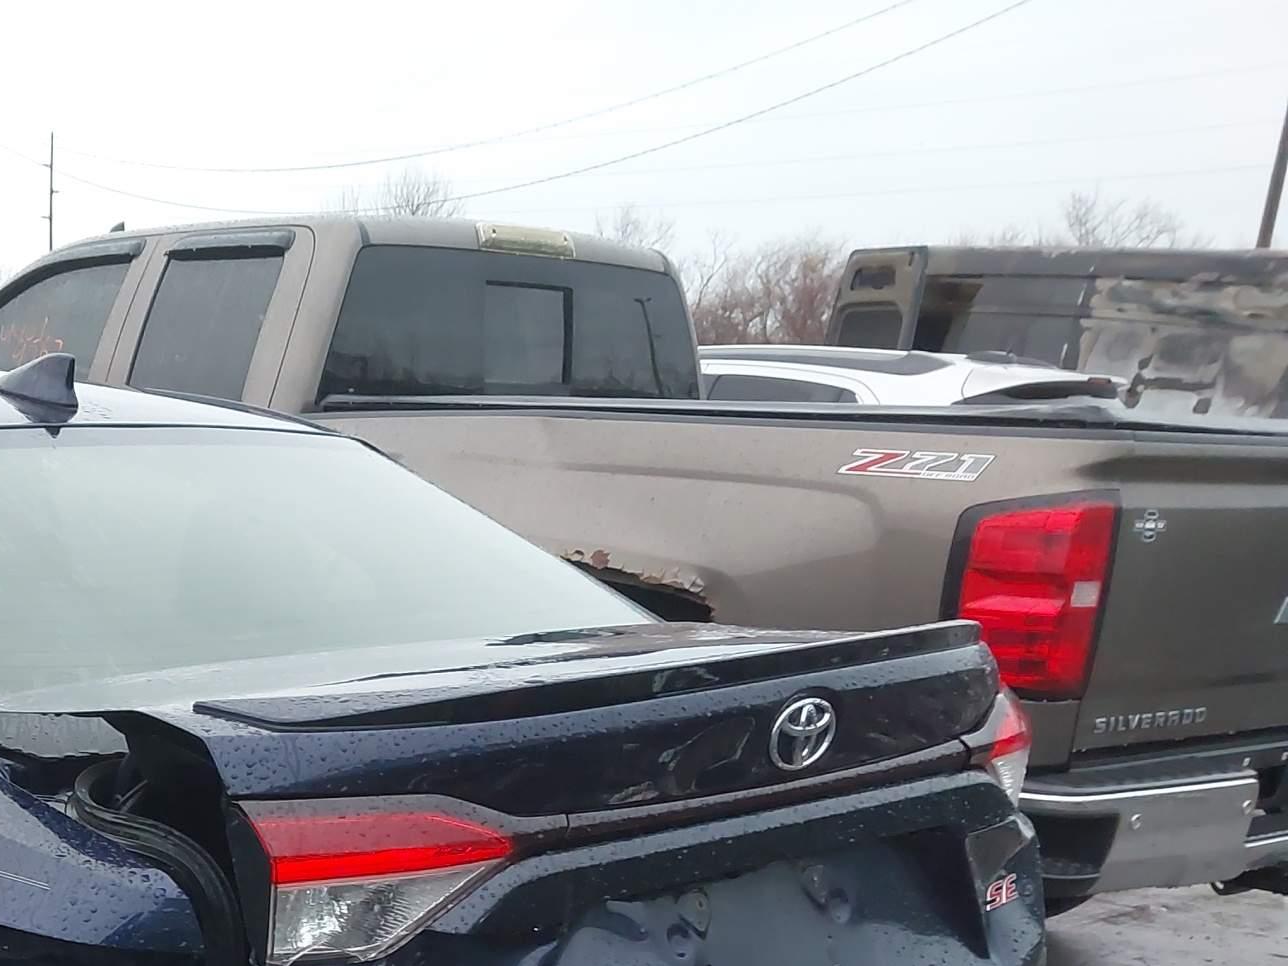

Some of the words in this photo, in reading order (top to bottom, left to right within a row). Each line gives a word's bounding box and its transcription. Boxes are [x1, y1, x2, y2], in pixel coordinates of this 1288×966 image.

[838, 449, 996, 478] Z71
[1093, 706, 1207, 734] SILVERADO
[985, 873, 1019, 912] SE
